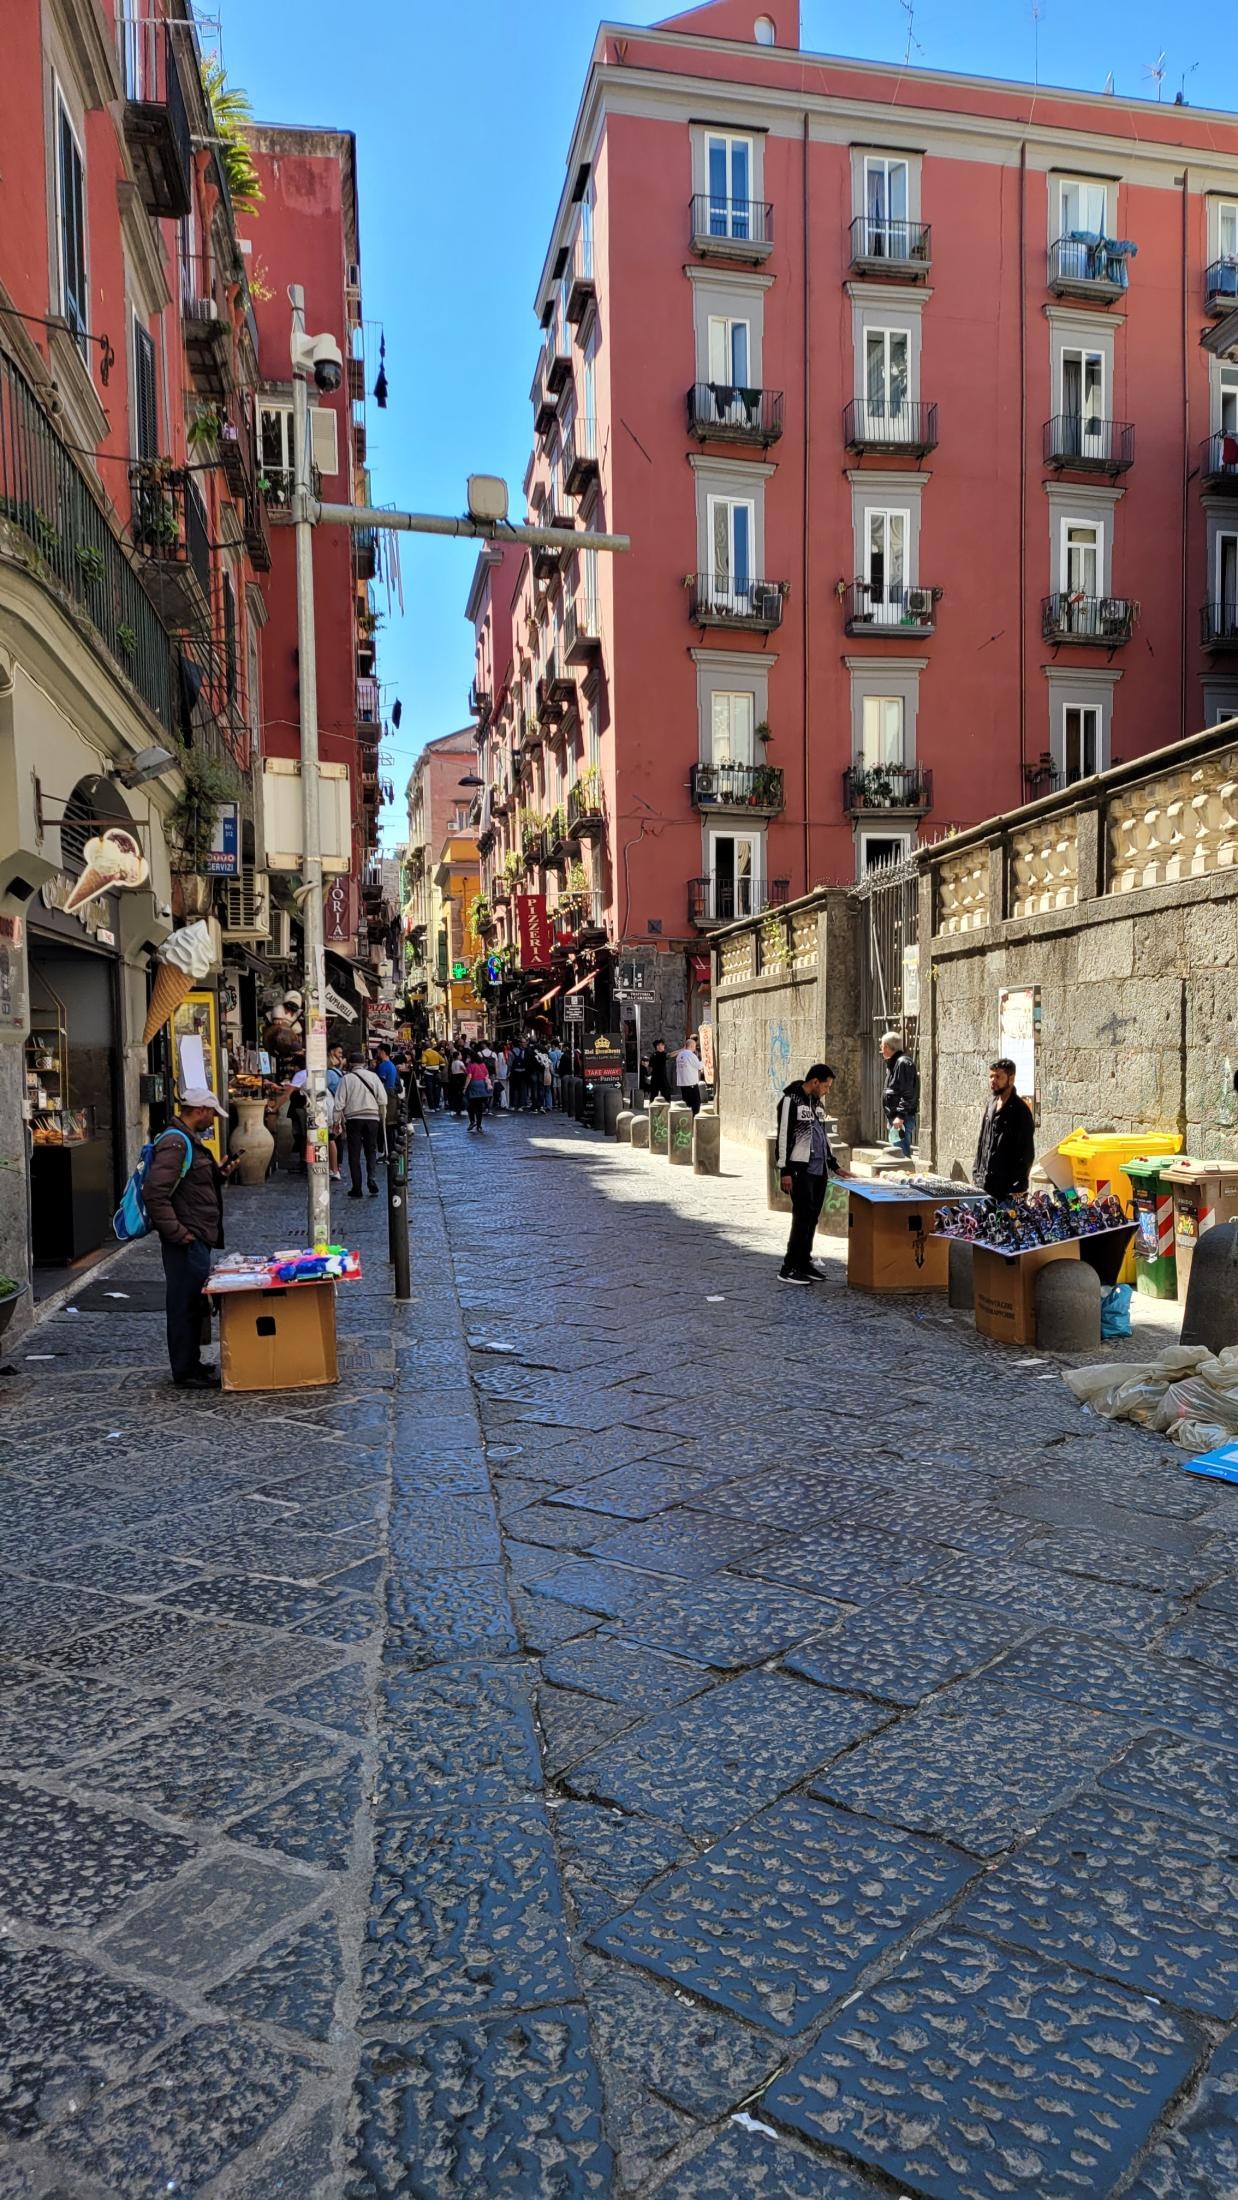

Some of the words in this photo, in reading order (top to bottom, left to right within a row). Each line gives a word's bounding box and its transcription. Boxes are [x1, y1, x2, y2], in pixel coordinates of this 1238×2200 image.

[207, 862, 234, 872] SERVIZI
[527, 898, 543, 963] PIZZERIA
[324, 991, 353, 1018] CAPPARELLI
[367, 1003, 391, 1011] PIZZA
[603, 1068, 620, 1076] AWAY
